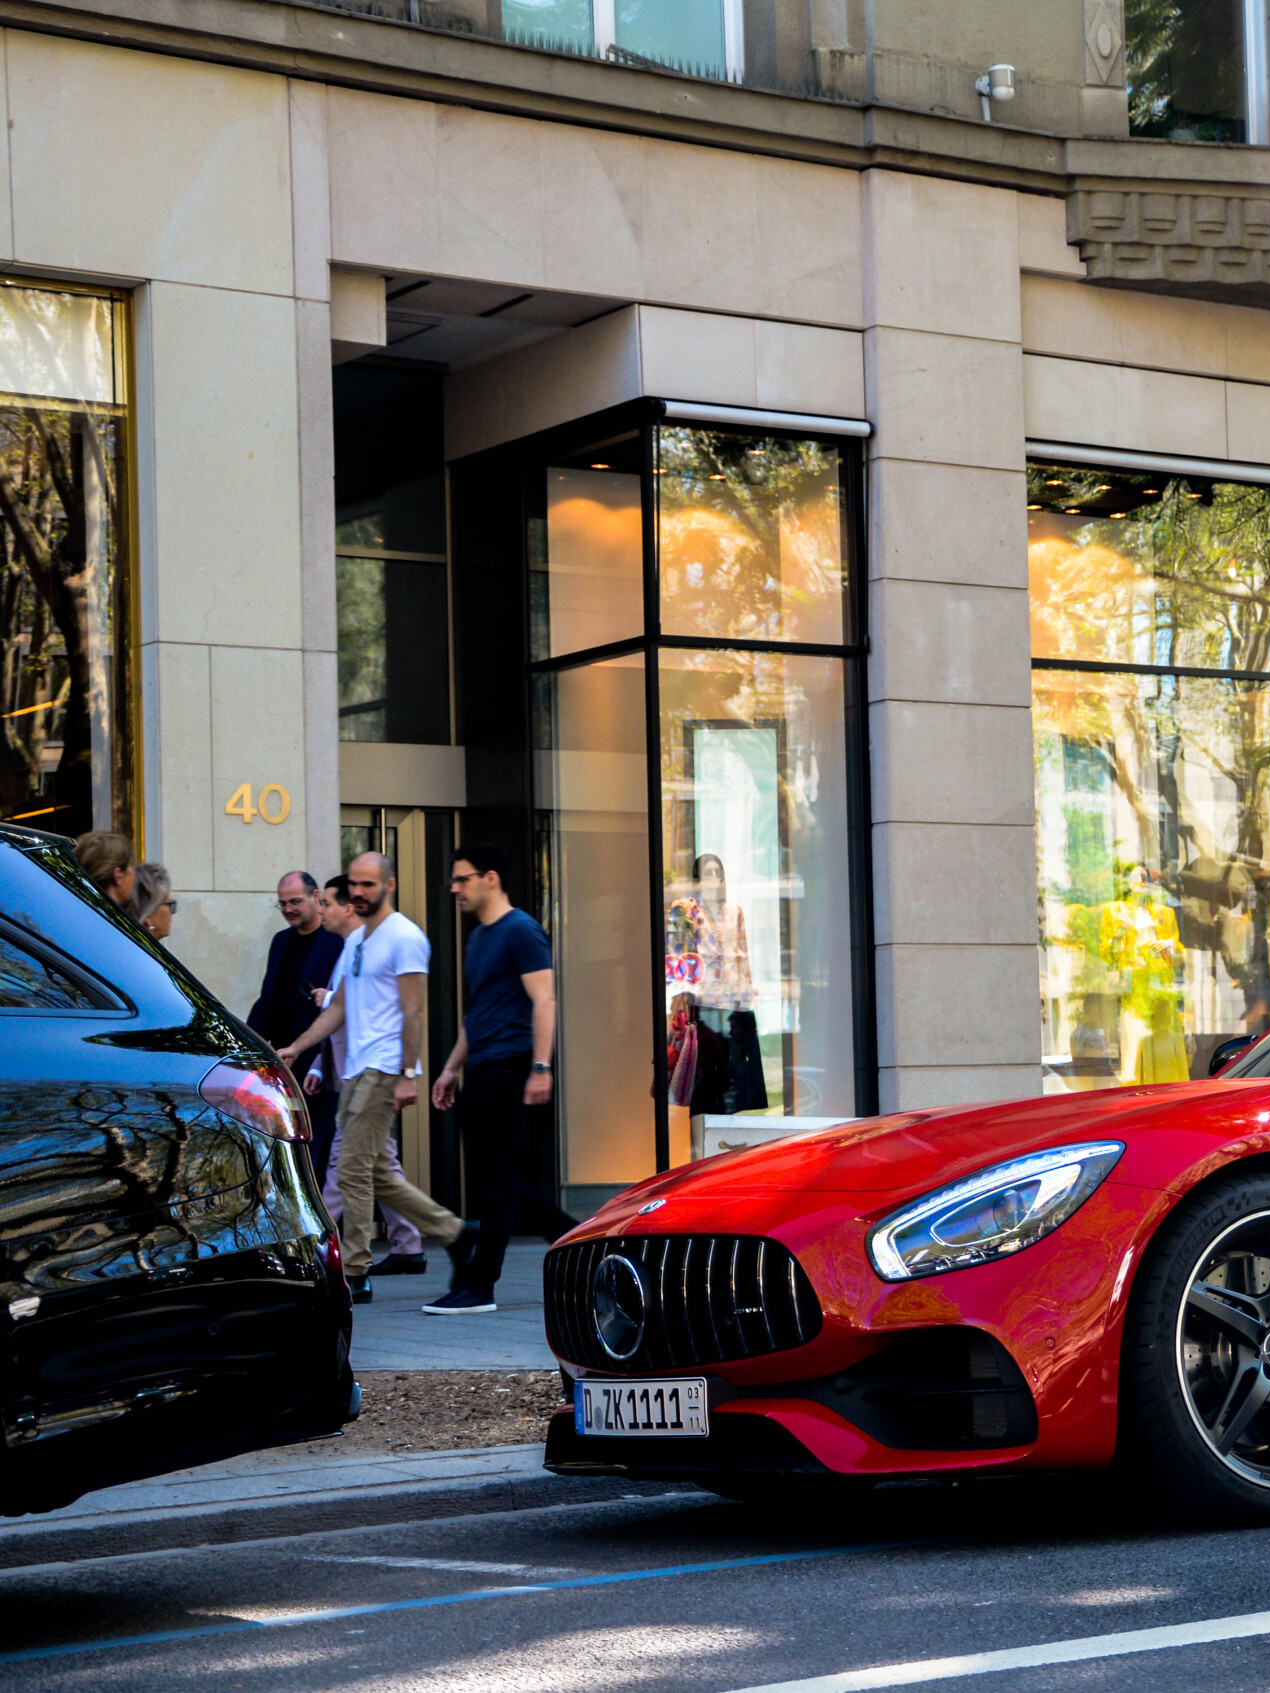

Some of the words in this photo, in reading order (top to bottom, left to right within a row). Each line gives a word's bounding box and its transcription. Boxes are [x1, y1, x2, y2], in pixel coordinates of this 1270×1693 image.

[225, 782, 291, 825] 40
[687, 1387, 699, 1399] 03
[584, 1388, 593, 1428] D
[690, 1417, 700, 1429] 11
